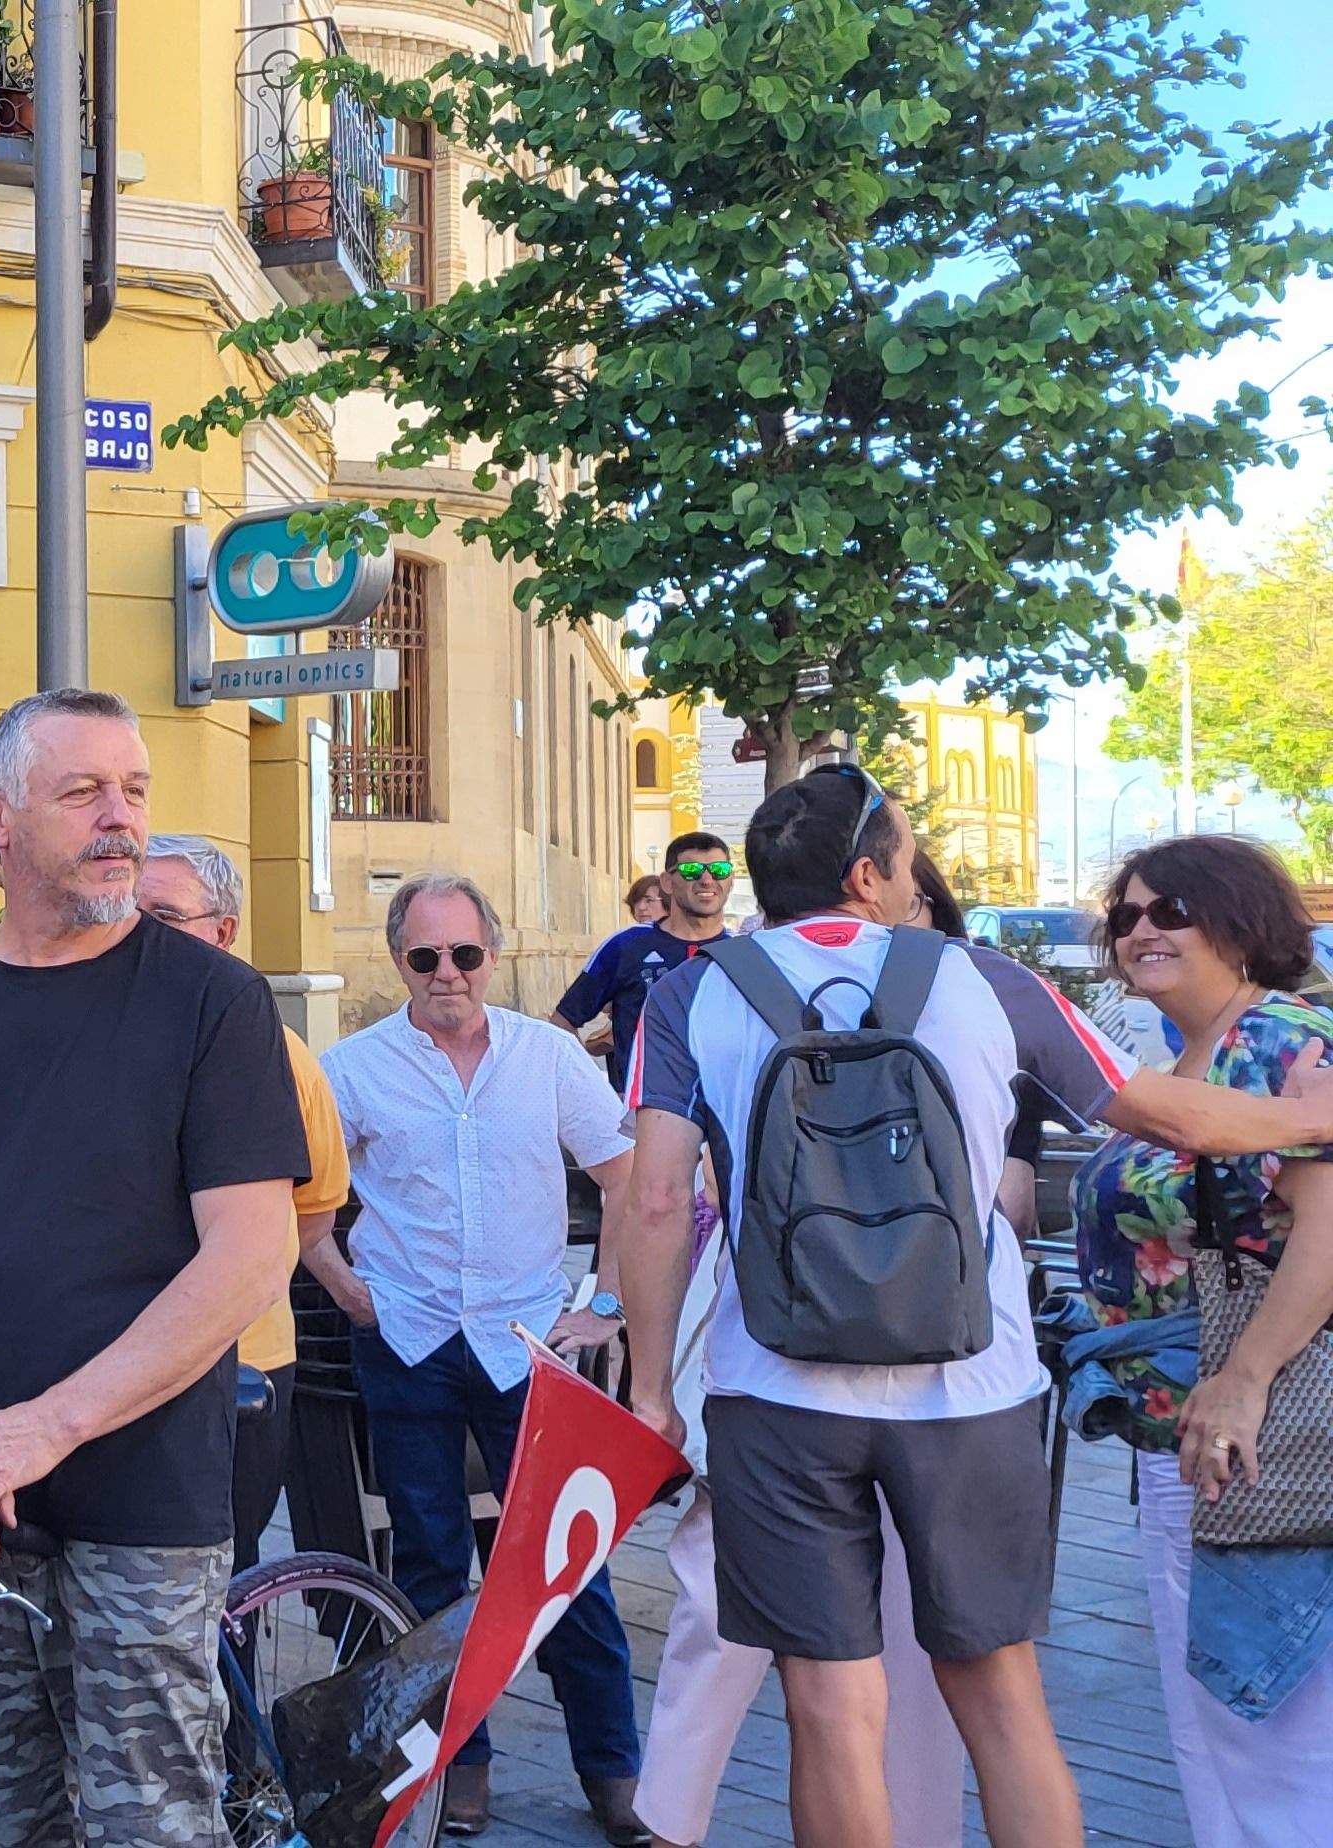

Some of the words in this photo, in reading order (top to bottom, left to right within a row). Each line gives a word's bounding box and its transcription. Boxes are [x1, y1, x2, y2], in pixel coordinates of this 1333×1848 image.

[85, 409, 147, 431] COSO
[86, 439, 148, 460] BAJO
[220, 665, 290, 688] natural
[298, 660, 365, 683] optics
